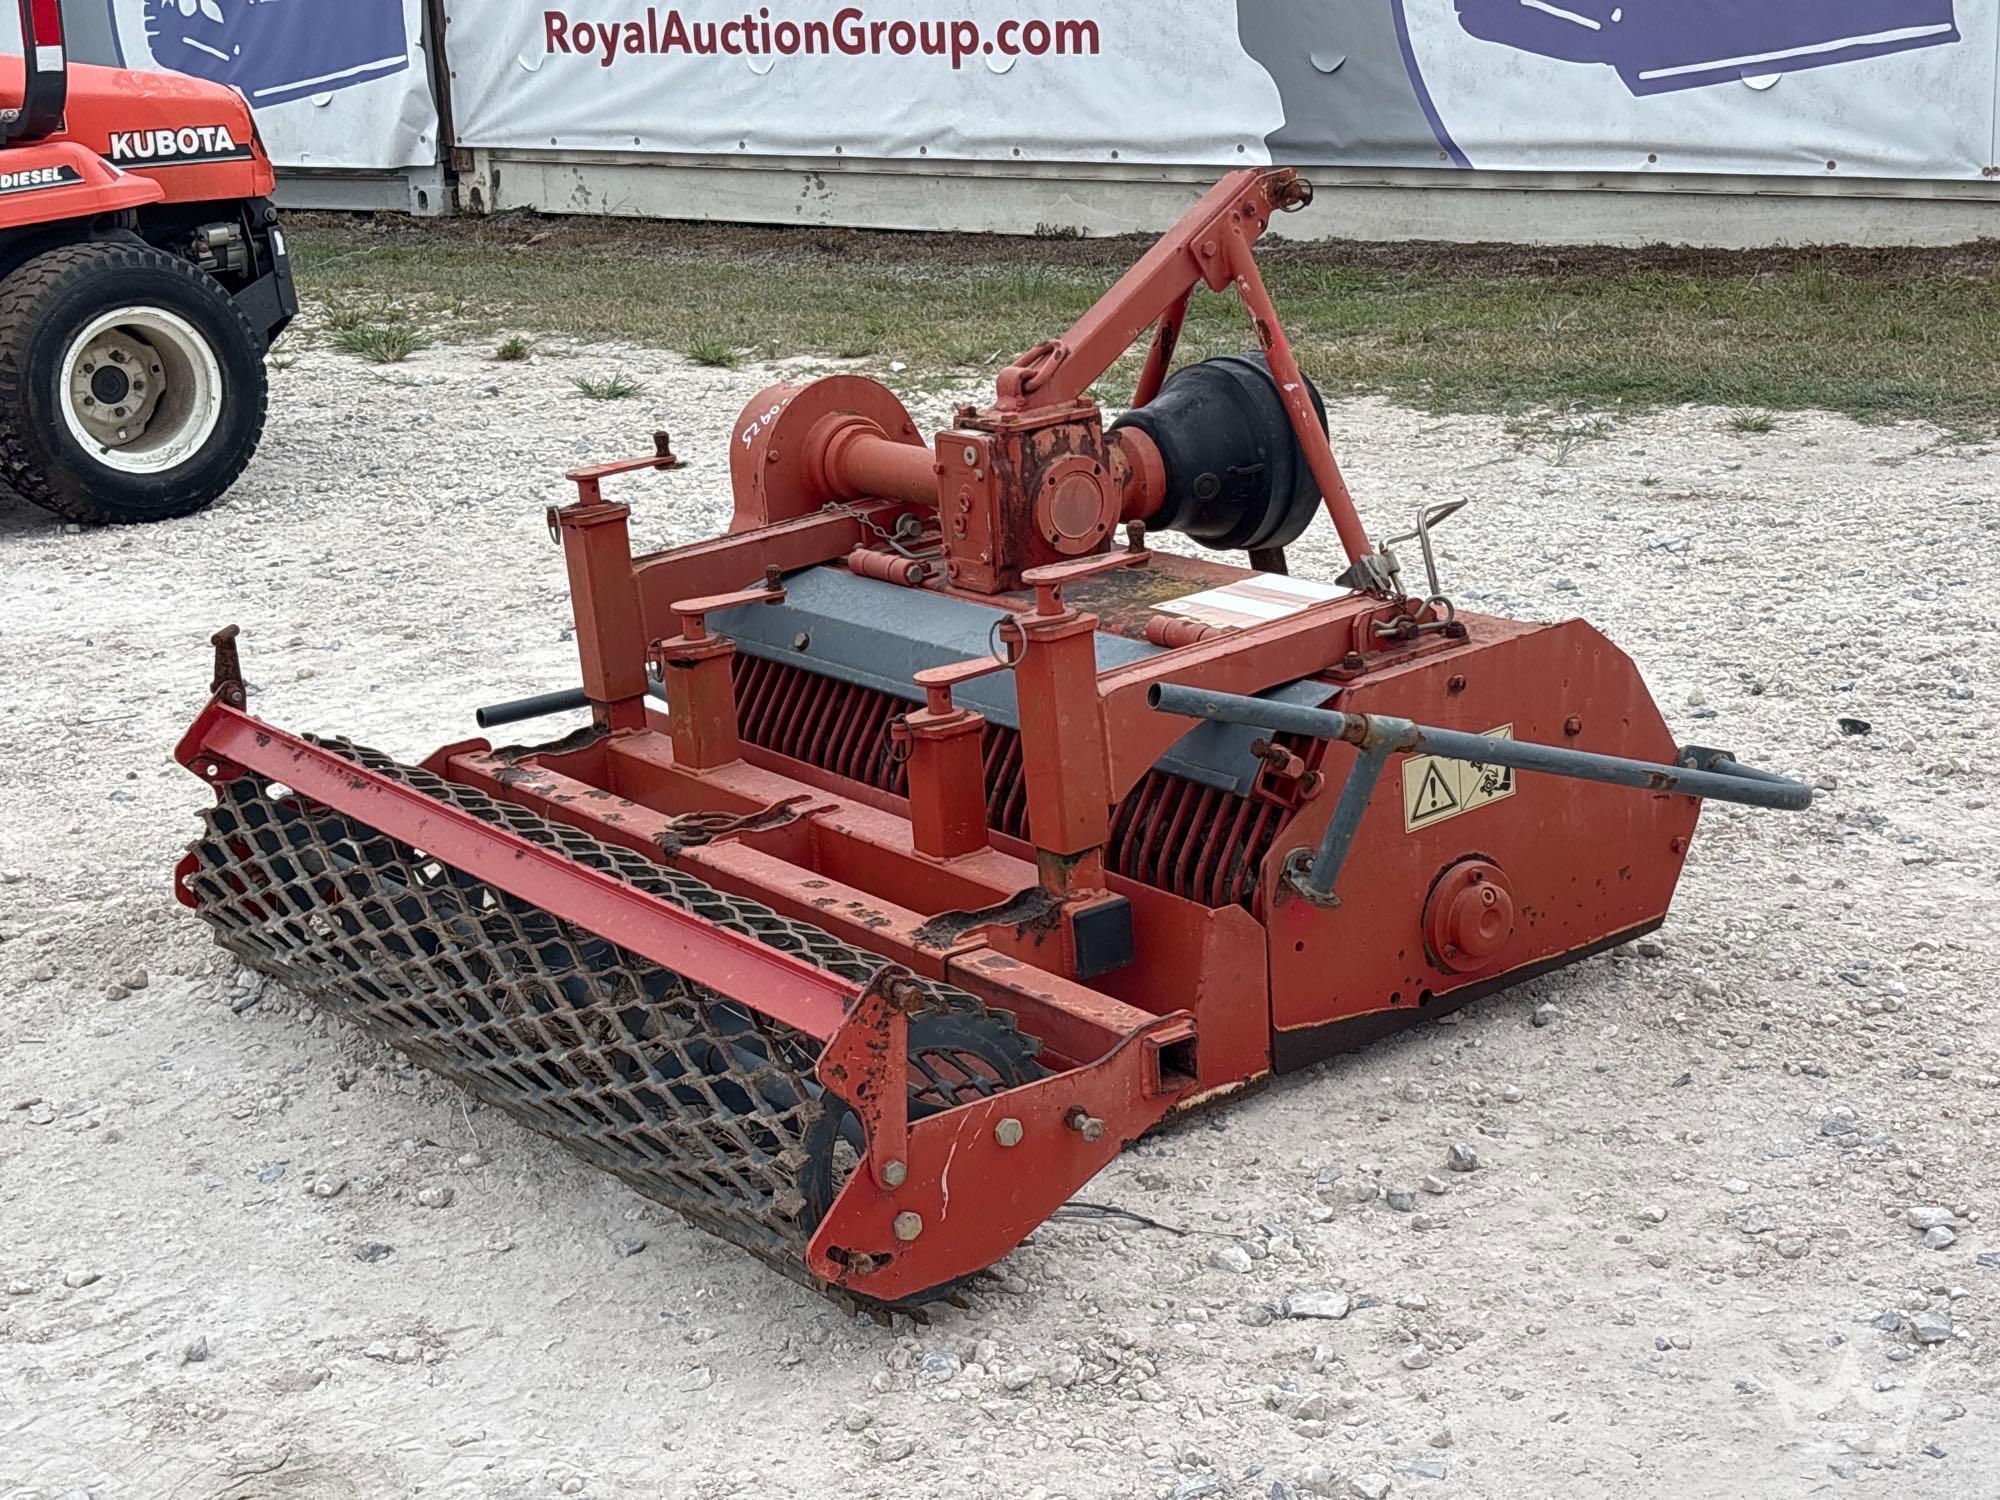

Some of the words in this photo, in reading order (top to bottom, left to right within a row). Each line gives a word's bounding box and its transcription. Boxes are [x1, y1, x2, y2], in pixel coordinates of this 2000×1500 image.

[544, 7, 1099, 69] RoyalAuctionGroup.com
[110, 126, 236, 160] KUBOTA
[0, 167, 63, 188] DIESEL
